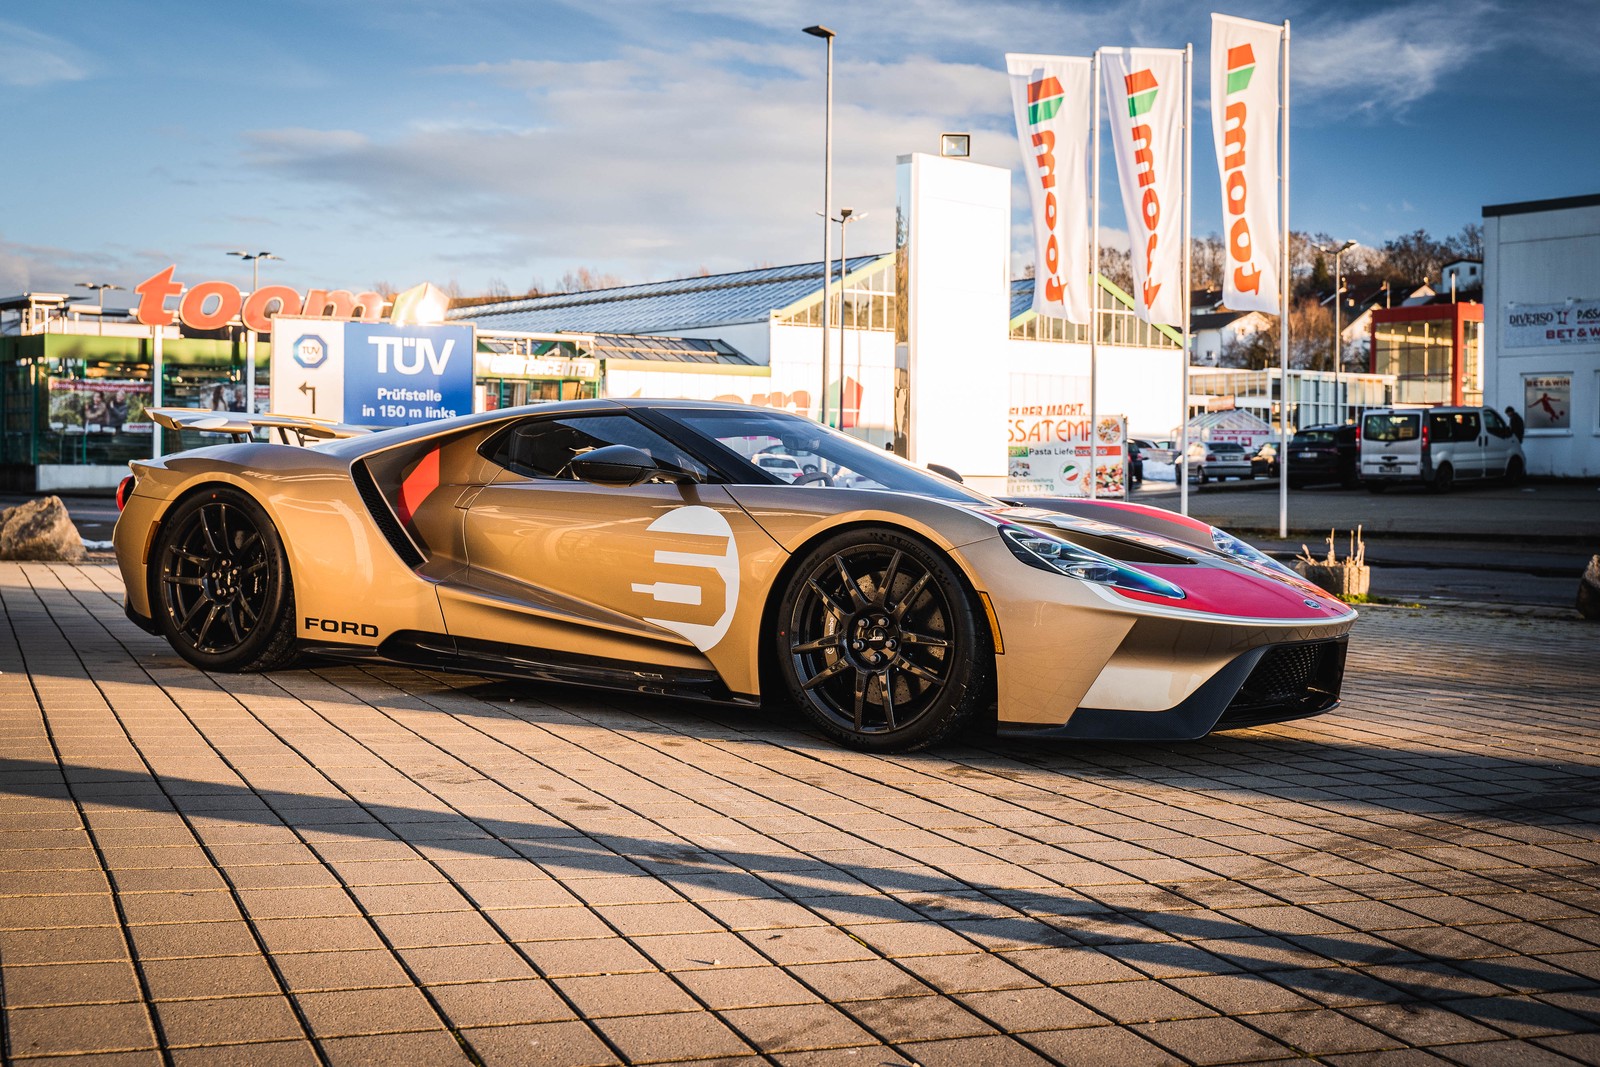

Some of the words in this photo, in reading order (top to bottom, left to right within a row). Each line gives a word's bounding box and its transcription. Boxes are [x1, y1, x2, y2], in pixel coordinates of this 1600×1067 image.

[1224, 101, 1262, 296] toom
[1031, 130, 1068, 305] toom
[135, 264, 383, 333] toom
[368, 336, 455, 376] TÜV
[377, 388, 442, 402] Prüfstelle
[362, 405, 375, 417] in
[379, 405, 406, 418] 150
[409, 408, 423, 418] m
[425, 406, 457, 419] links
[1029, 447, 1052, 456] Pasta
[304, 617, 379, 638] FORD
